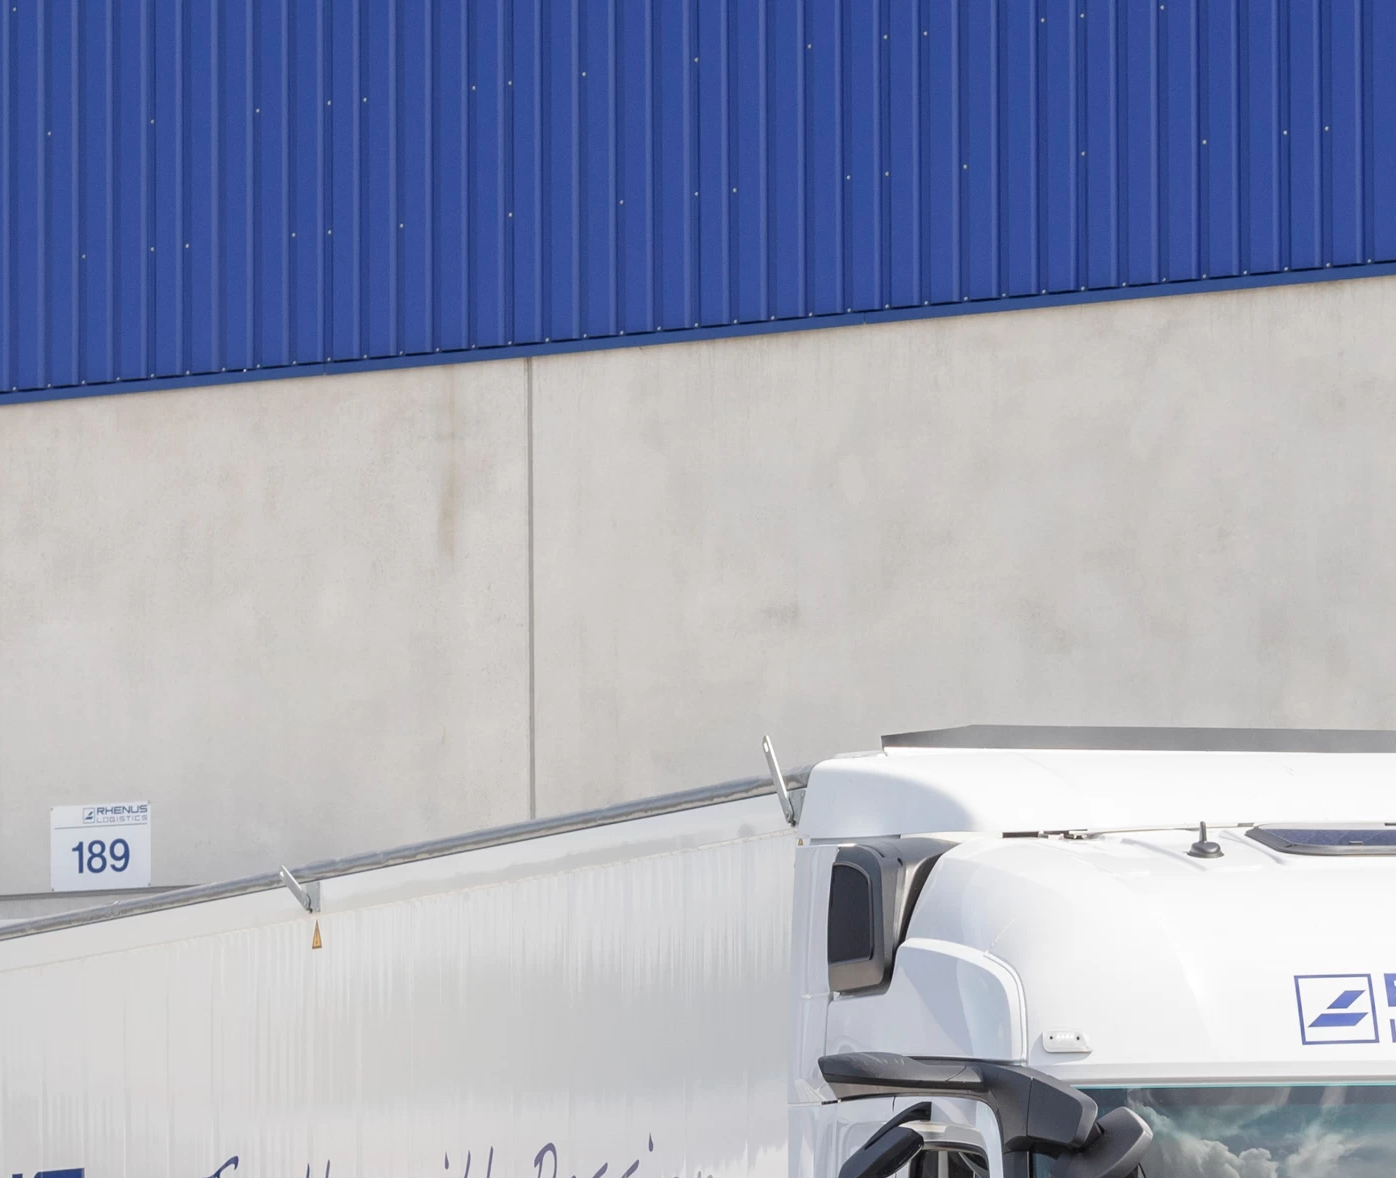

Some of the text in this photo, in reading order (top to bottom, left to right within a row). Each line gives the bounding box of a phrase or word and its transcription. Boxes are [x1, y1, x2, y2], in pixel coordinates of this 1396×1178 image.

[96, 804, 148, 815] RHENUS
[96, 815, 148, 824] LOGISTICS
[71, 838, 130, 874] 189
